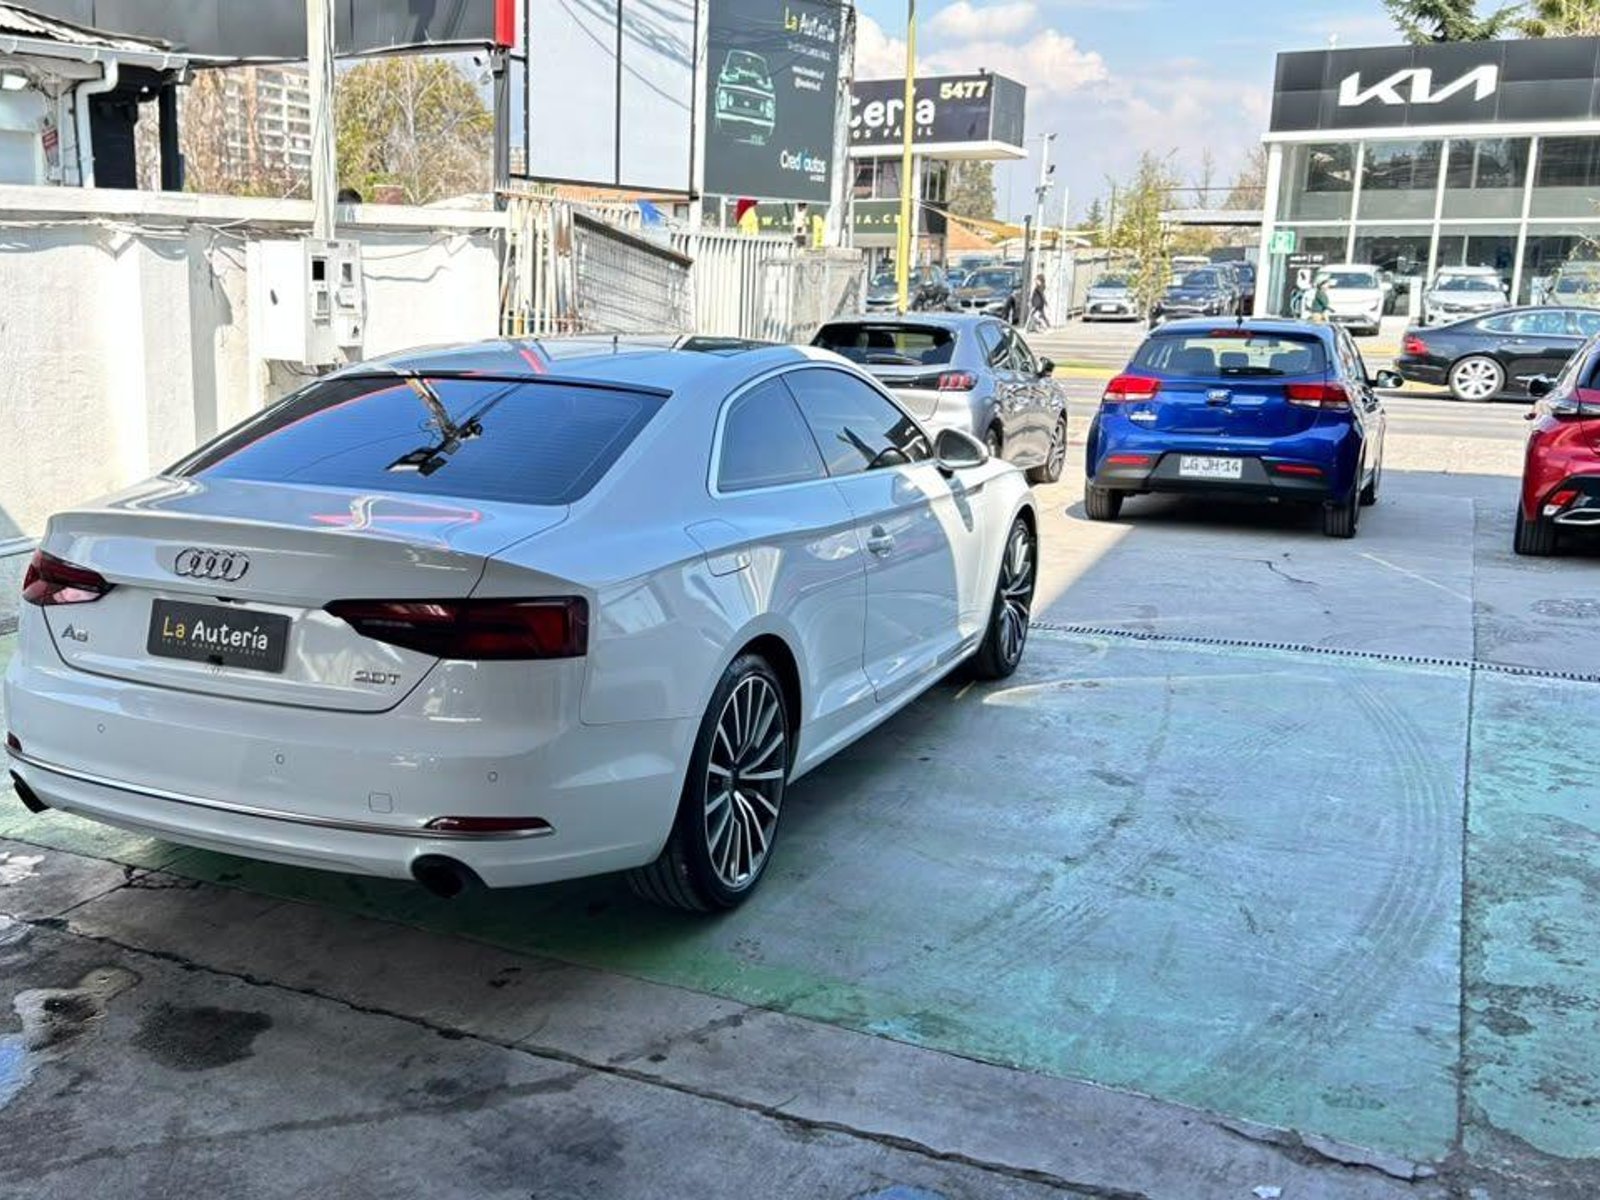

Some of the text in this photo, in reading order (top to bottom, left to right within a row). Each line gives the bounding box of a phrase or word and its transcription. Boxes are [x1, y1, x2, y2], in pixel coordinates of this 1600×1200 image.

[940, 81, 988, 100] 5477
[1338, 64, 1498, 106] KIA
[163, 616, 186, 640] La
[191, 619, 269, 650] Autería
